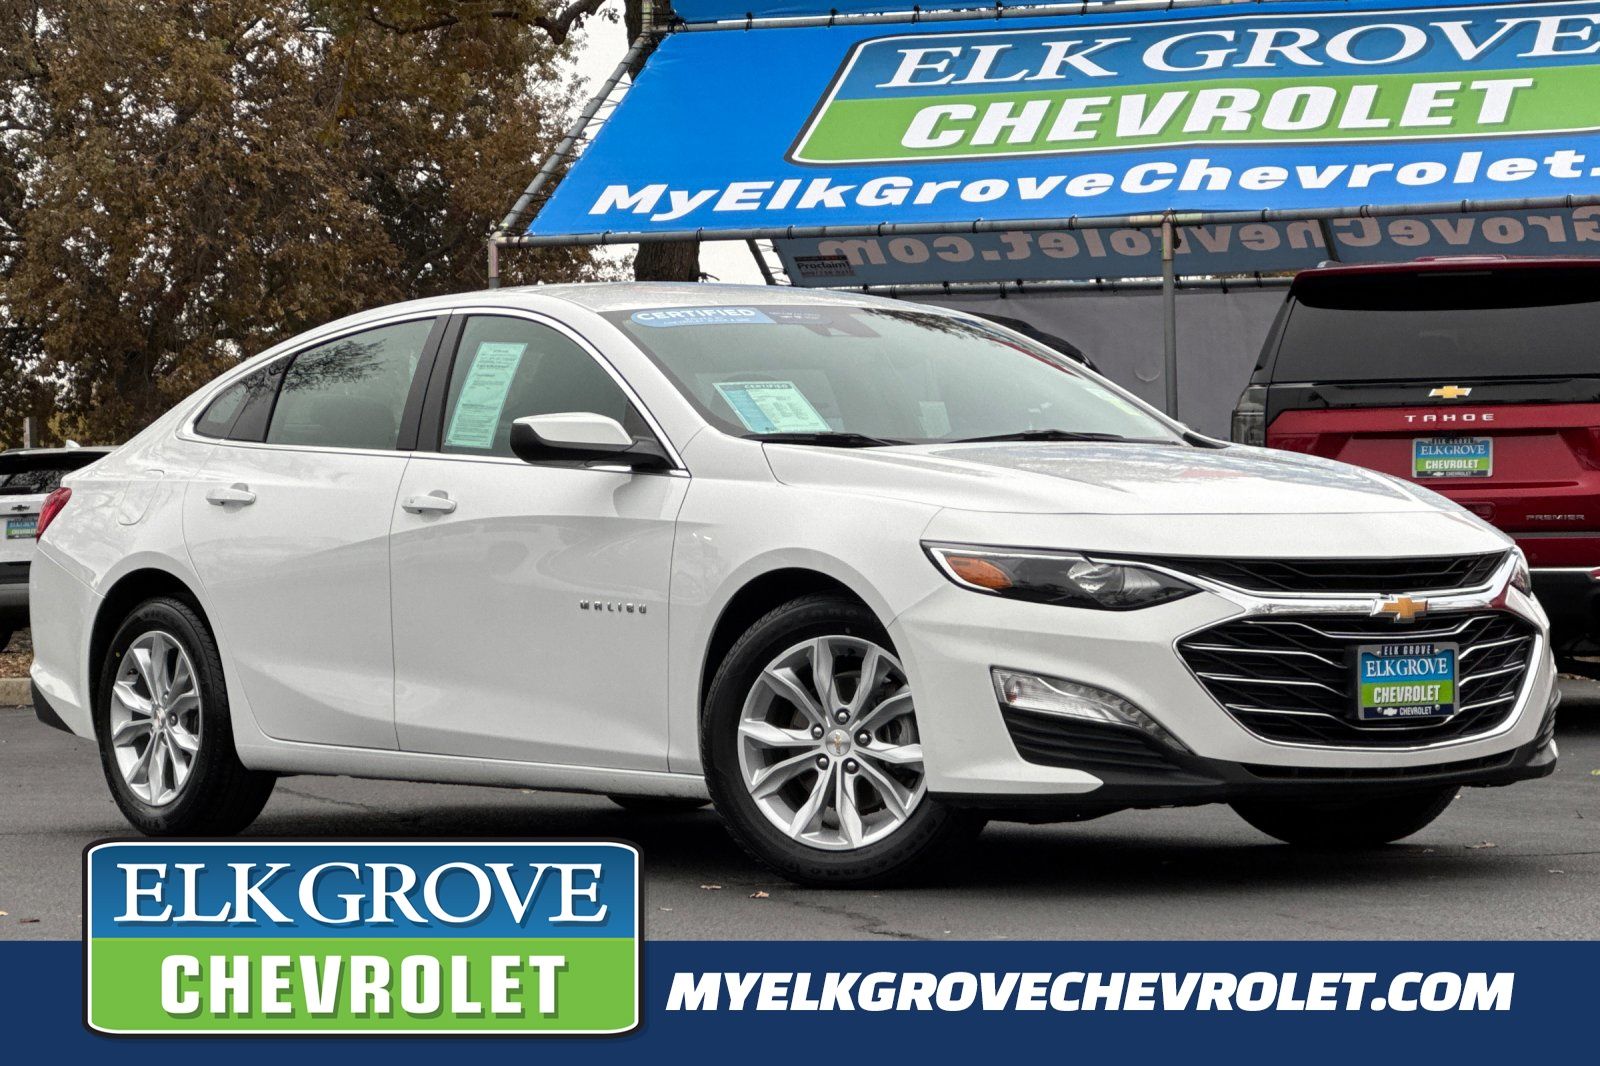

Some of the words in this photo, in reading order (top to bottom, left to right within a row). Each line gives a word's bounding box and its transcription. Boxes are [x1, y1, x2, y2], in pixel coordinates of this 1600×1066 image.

[875, 37, 1132, 88] ELK
[1142, 13, 1600, 72] GROVE
[901, 77, 1534, 149] CHEVROLET
[636, 308, 756, 321] CERTIFIED
[1404, 413, 1494, 422] TAHOE
[1421, 445, 1444, 456] ELK
[1445, 444, 1485, 455] GROVE
[1425, 459, 1479, 470] CHEVROLET
[580, 600, 647, 613] MALIBU
[1384, 646, 1399, 655] ELK
[1403, 645, 1431, 655] GROVE
[1366, 659, 1396, 677] ELK
[1396, 657, 1448, 676] GROVE
[1374, 685, 1440, 704] CHEVROLET
[1400, 706, 1432, 715] CHEVROLET
